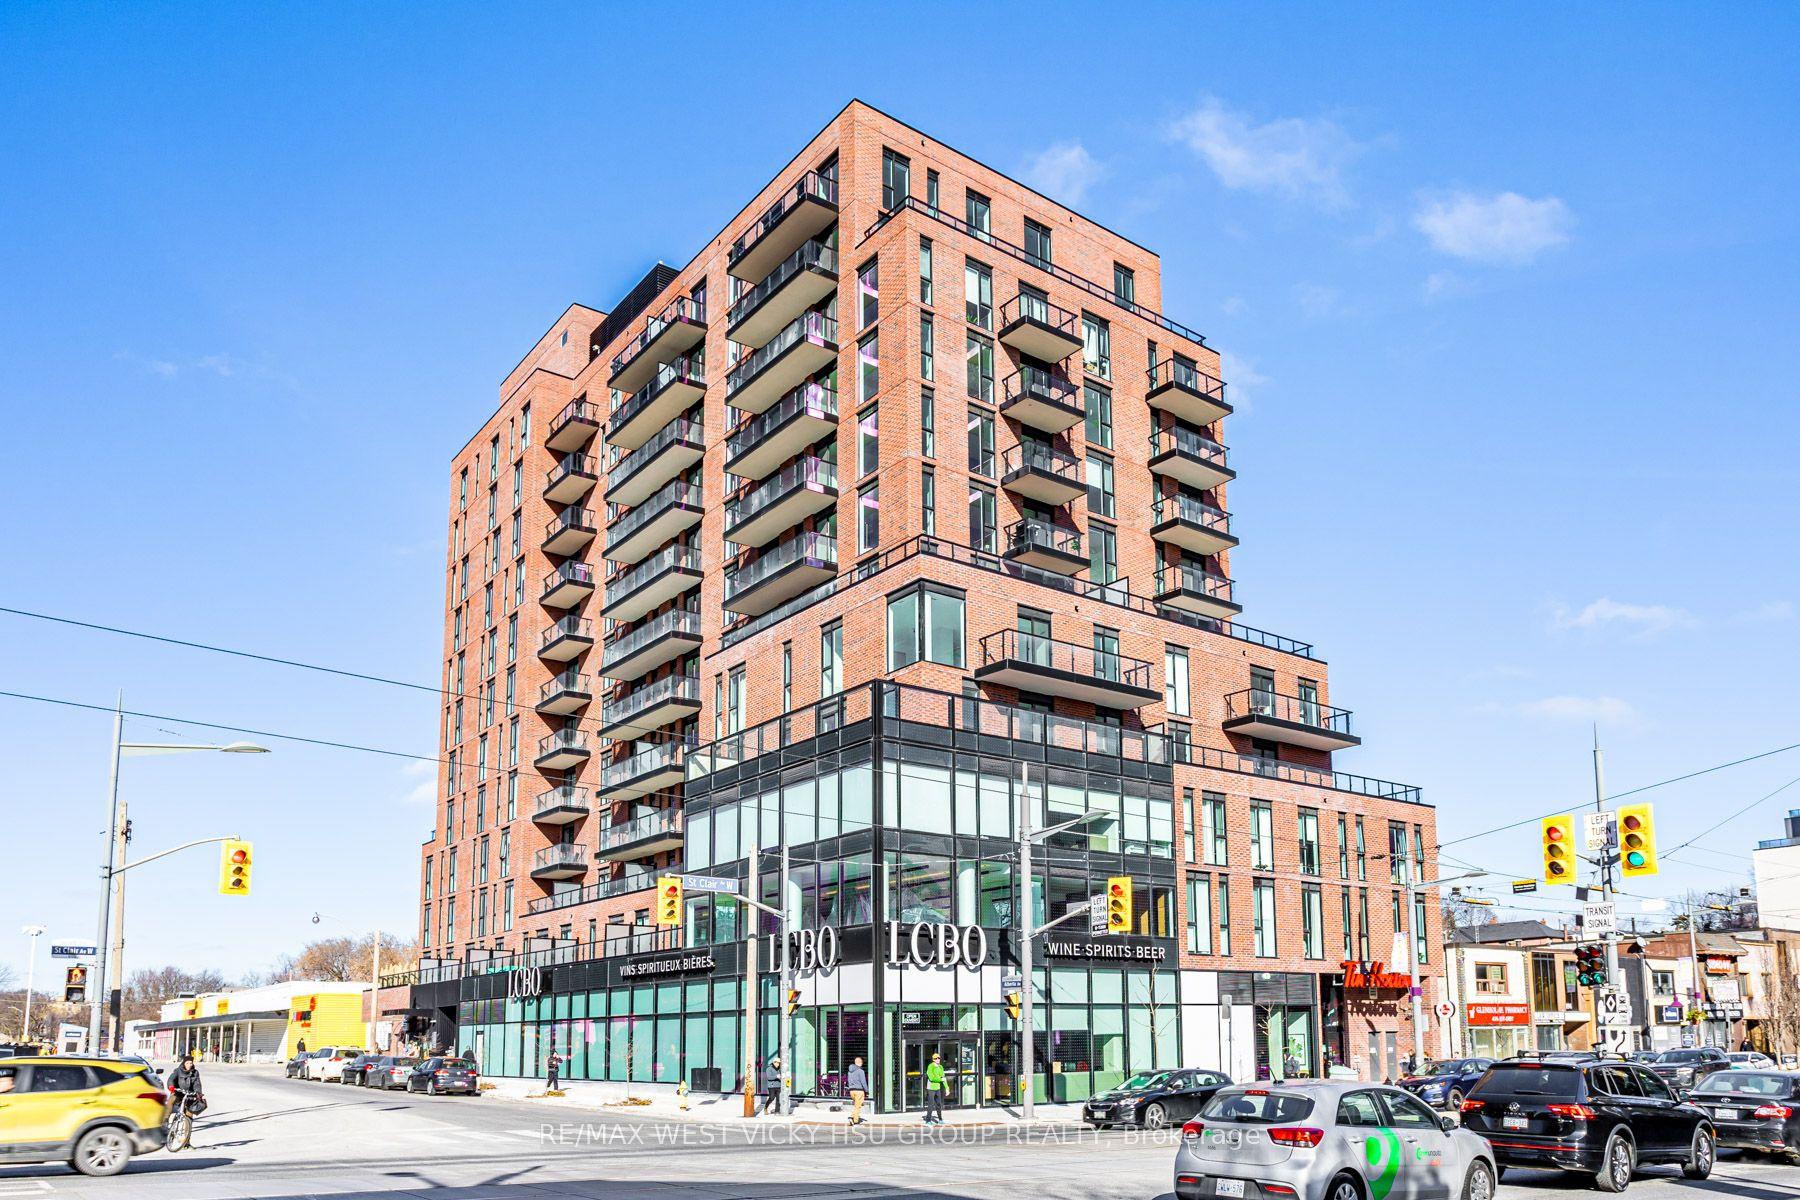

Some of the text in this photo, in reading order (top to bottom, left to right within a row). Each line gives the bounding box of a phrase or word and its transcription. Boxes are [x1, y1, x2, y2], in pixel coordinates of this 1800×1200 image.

[1590, 814, 1609, 825] LEFT
[1592, 825, 1612, 836] TURN
[1588, 837, 1614, 848] SIGNAL
[688, 877, 696, 886] St
[700, 878, 718, 888] Clair
[726, 881, 733, 890] W
[1093, 896, 1106, 906] LEFT
[1093, 906, 1107, 914] TURN
[1586, 906, 1612, 916] TRANSIT
[1092, 915, 1108, 924] SIGNAL
[1588, 918, 1612, 928] SIGNAL
[769, 925, 836, 973] LCBO
[888, 920, 988, 967] LCBO
[1048, 942, 1166, 959] WINE SPIRITS BEER
[620, 956, 713, 976] VINS SPIRITUEUX BIÈRES
[1370, 960, 1412, 988] Horton
[508, 966, 542, 998] LCBO
